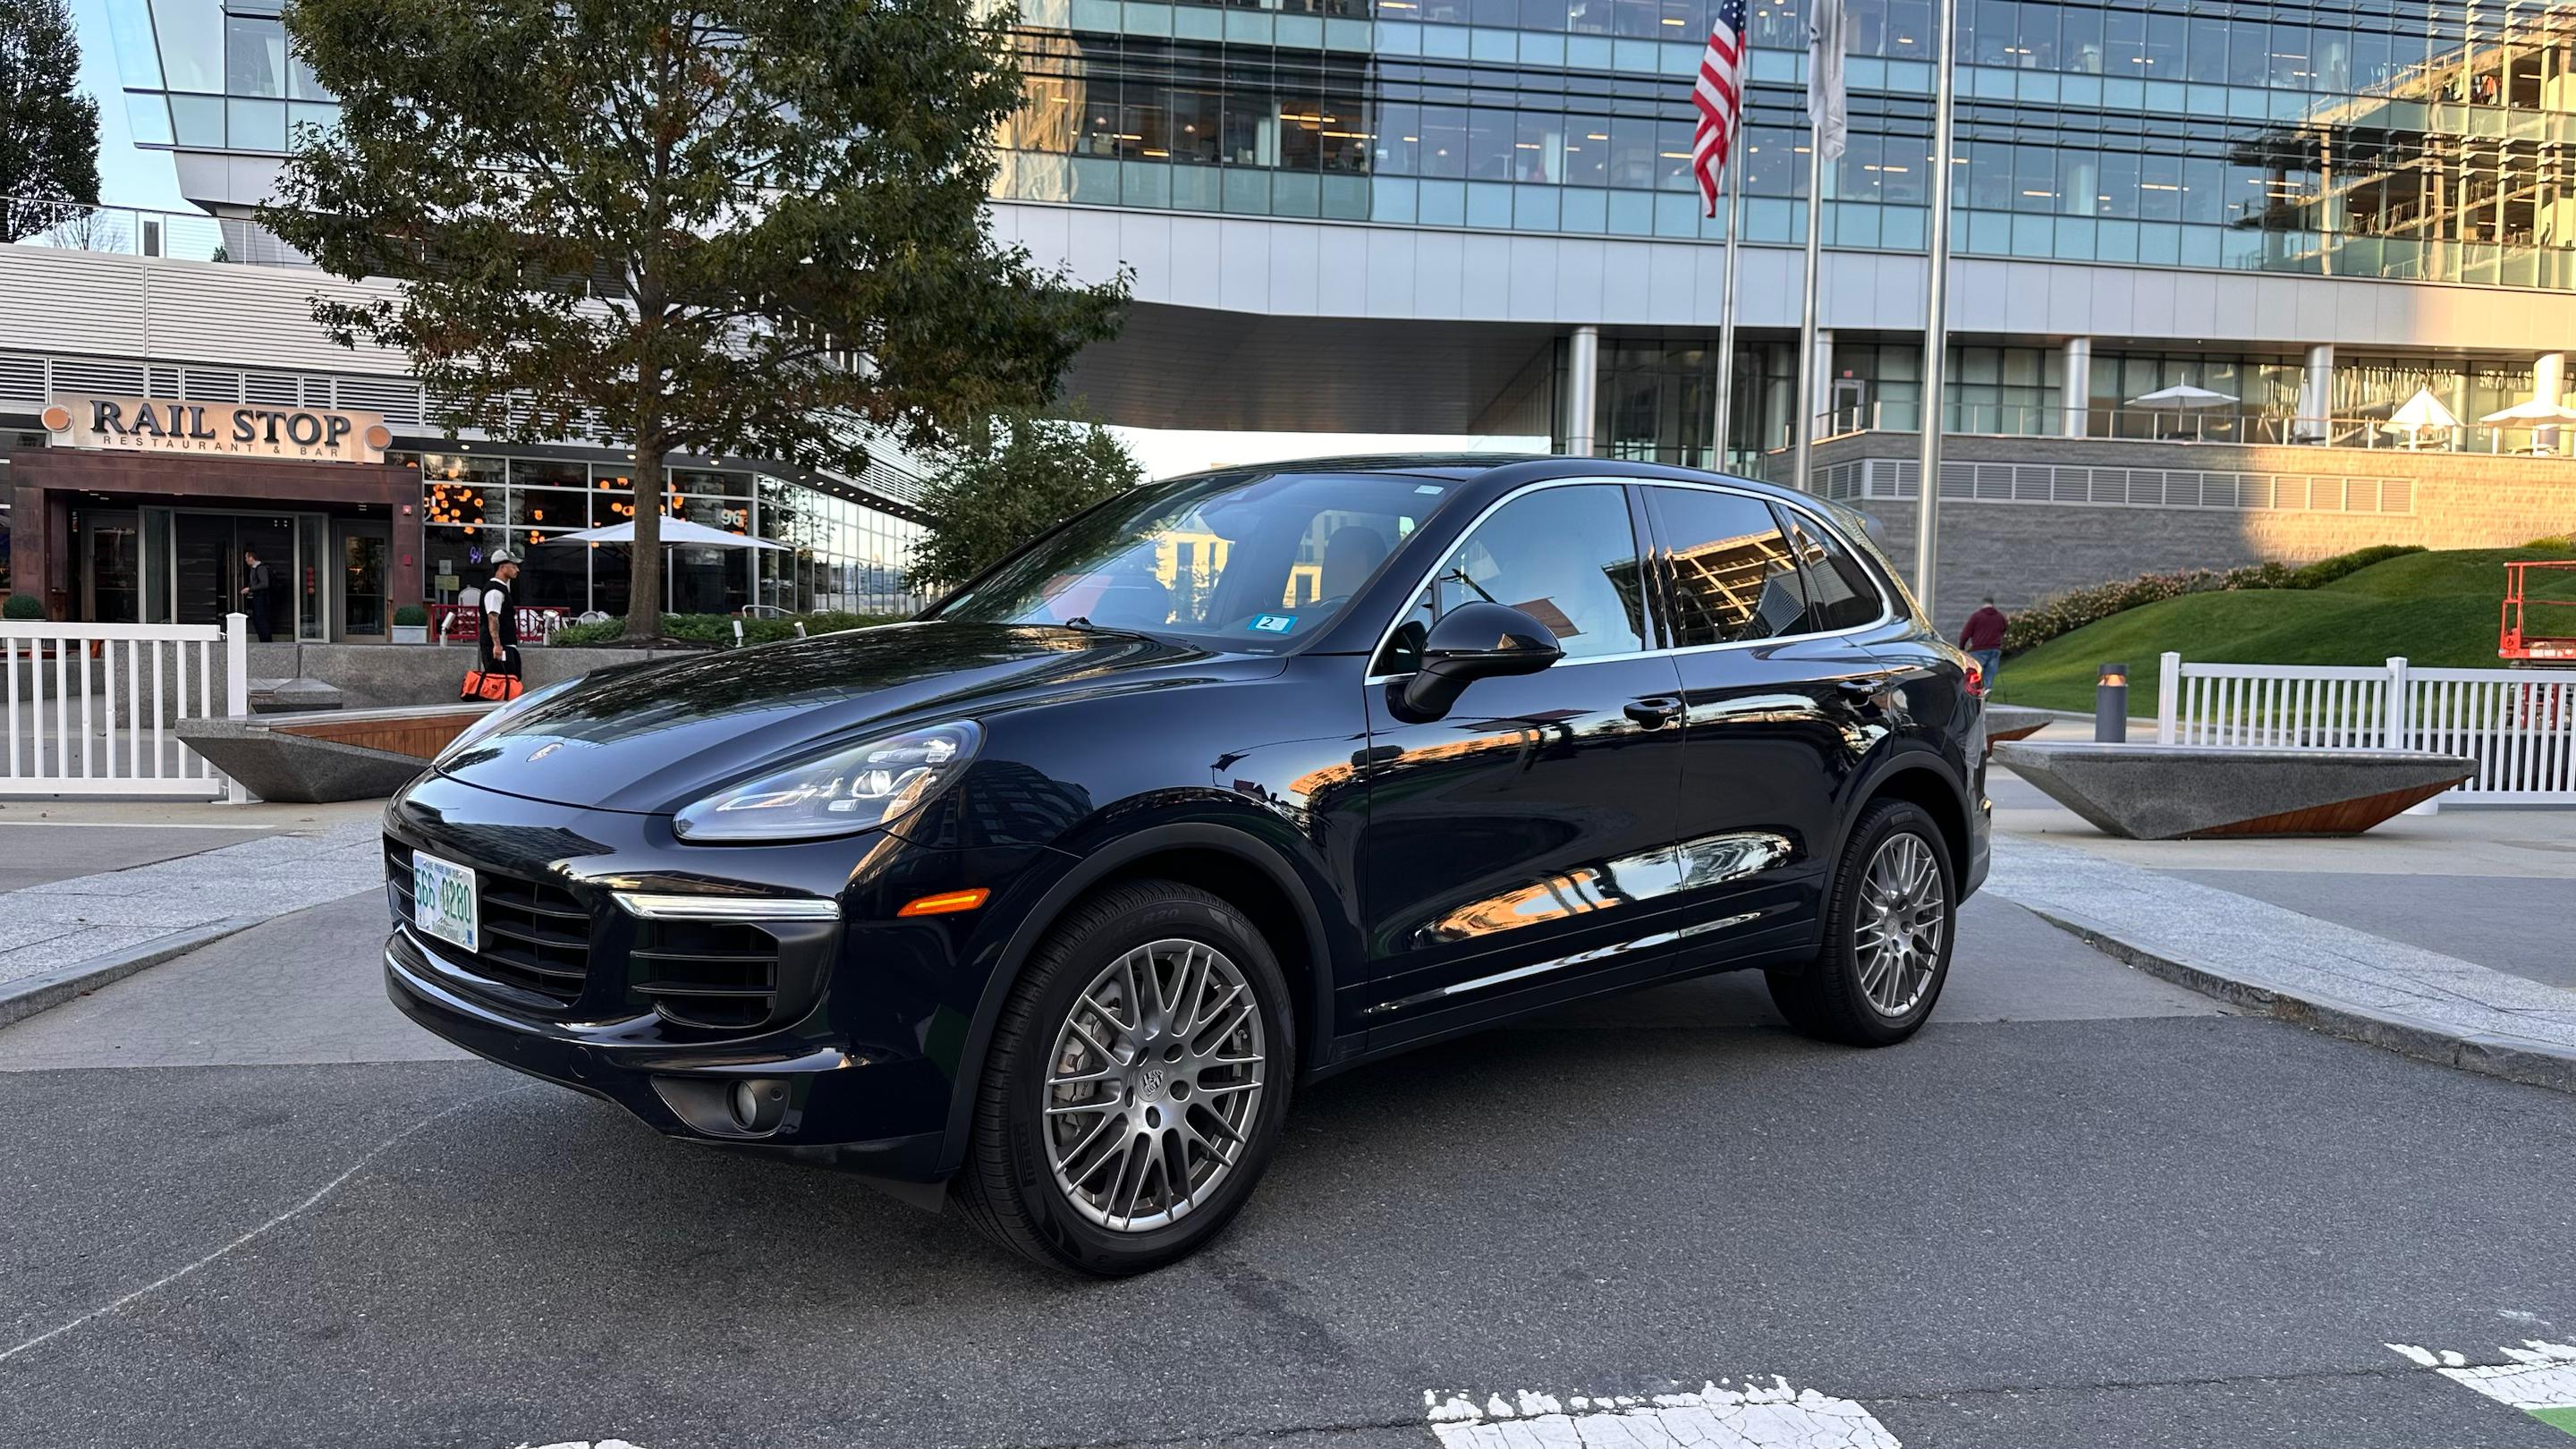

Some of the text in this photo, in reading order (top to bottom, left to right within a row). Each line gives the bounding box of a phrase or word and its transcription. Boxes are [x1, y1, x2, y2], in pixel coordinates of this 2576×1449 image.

[90, 400, 351, 447] RAIL STOP
[103, 436, 338, 457] RESTAURANT & BAR
[721, 509, 745, 528] 96
[1260, 617, 1275, 628] 2
[415, 867, 471, 924] 566 0280
